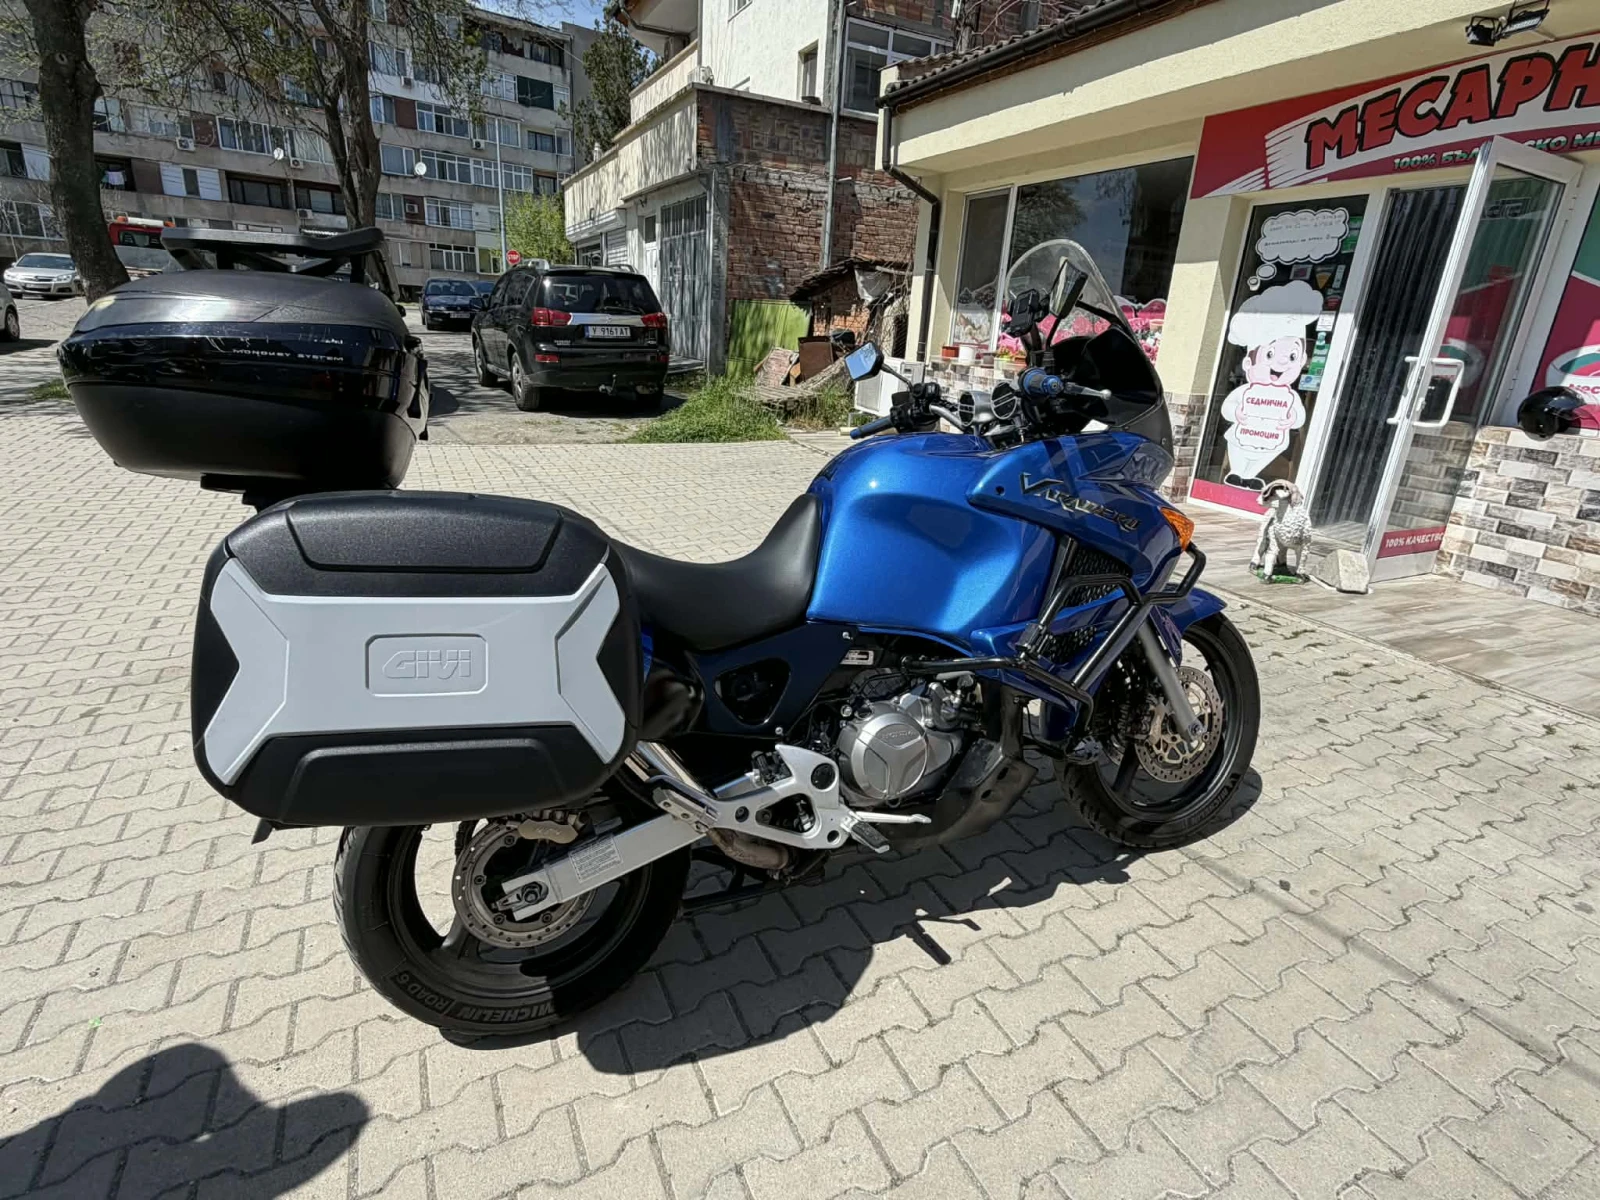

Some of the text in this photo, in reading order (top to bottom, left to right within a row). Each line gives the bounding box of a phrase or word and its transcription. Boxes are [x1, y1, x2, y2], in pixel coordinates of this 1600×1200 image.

[1393, 152, 1436, 170] 100%
[297, 353, 344, 362] SYSTEM
[1246, 397, 1288, 408] СЕДМИЧНА
[1240, 428, 1279, 440] ПРОМОЦИЯ
[1386, 537, 1405, 548] 100%
[382, 649, 472, 680] GIVI
[396, 971, 410, 983] 6
[406, 980, 449, 1012] ROAD
